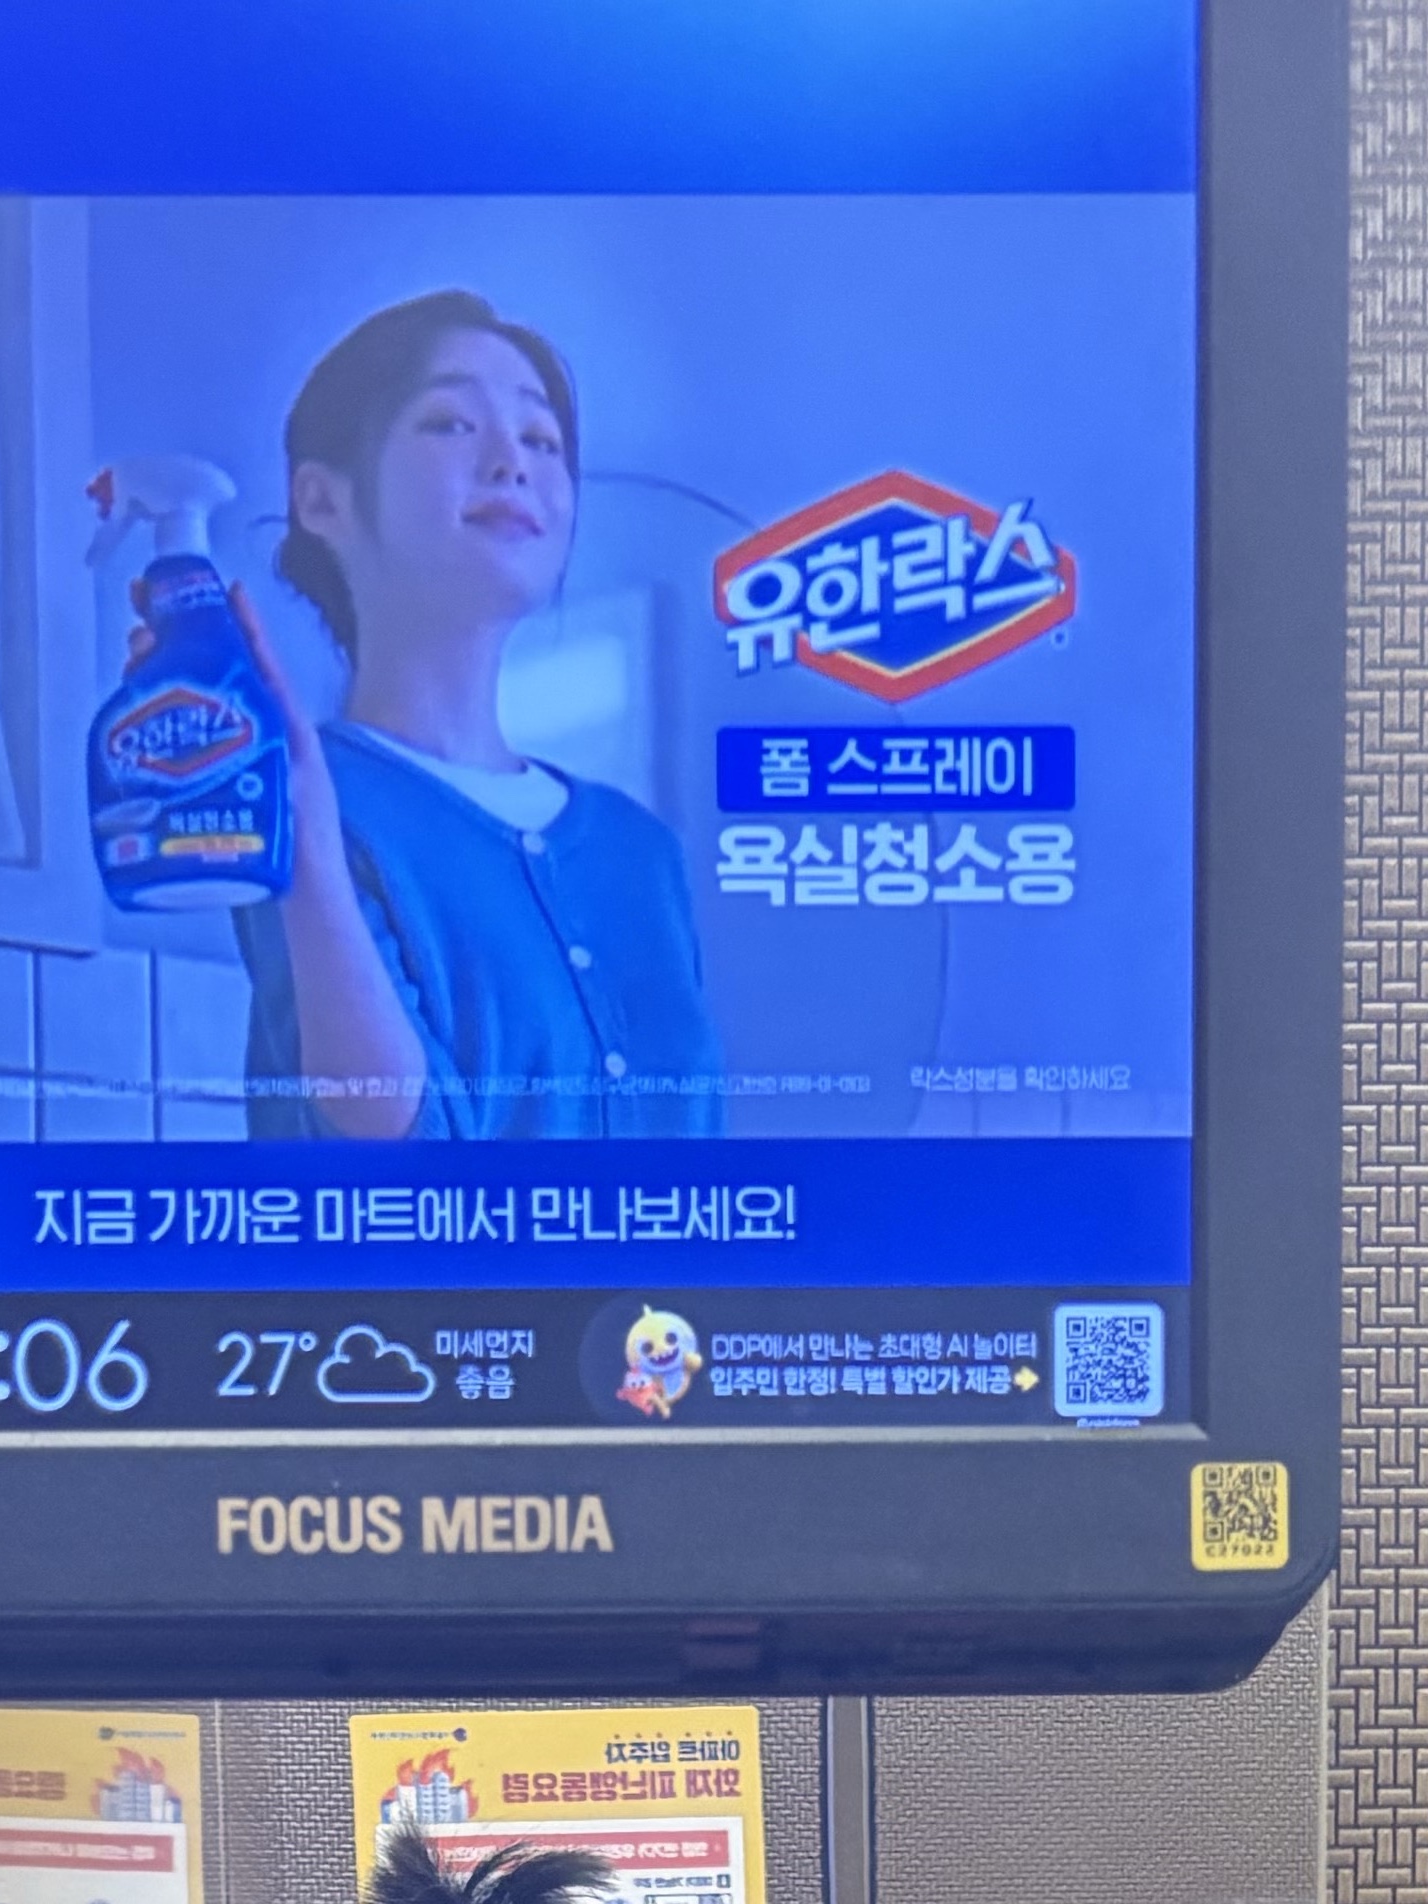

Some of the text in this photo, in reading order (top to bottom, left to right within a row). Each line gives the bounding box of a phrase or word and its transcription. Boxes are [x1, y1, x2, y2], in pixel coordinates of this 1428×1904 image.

[725, 498, 1066, 676] 유한락스
[759, 736, 1033, 797] 폼 스프레이
[716, 822, 1075, 906] 욕실청소용
[34, 1183, 796, 1245] 지금 가까운 마트에서 만나보세요!
[435, 1328, 534, 1361] 미세먼지
[711, 1332, 804, 1361] DDP에서
[809, 1332, 873, 1361] 만나는
[455, 1367, 516, 1401] 좋음
[218, 1494, 614, 1557] FOCUS MEDIA
